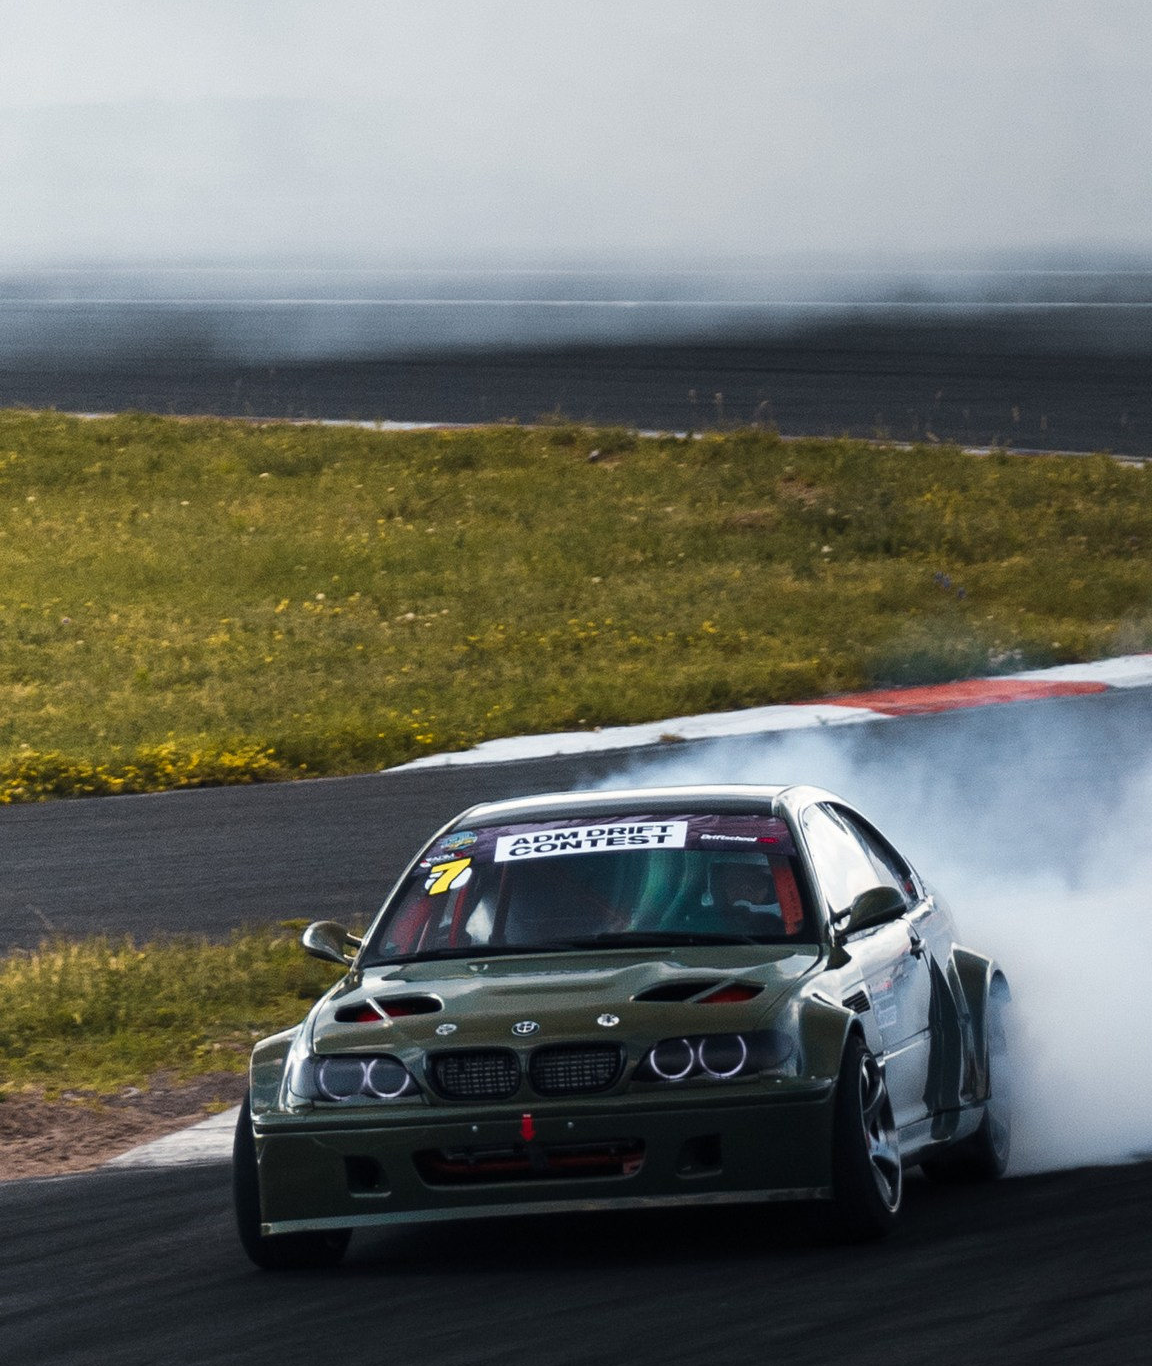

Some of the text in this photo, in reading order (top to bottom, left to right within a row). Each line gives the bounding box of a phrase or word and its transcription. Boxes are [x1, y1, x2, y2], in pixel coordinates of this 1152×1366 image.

[508, 834, 673, 857] CONTEST
[511, 824, 675, 847] ADM DRIFT
[429, 857, 472, 896] 7
